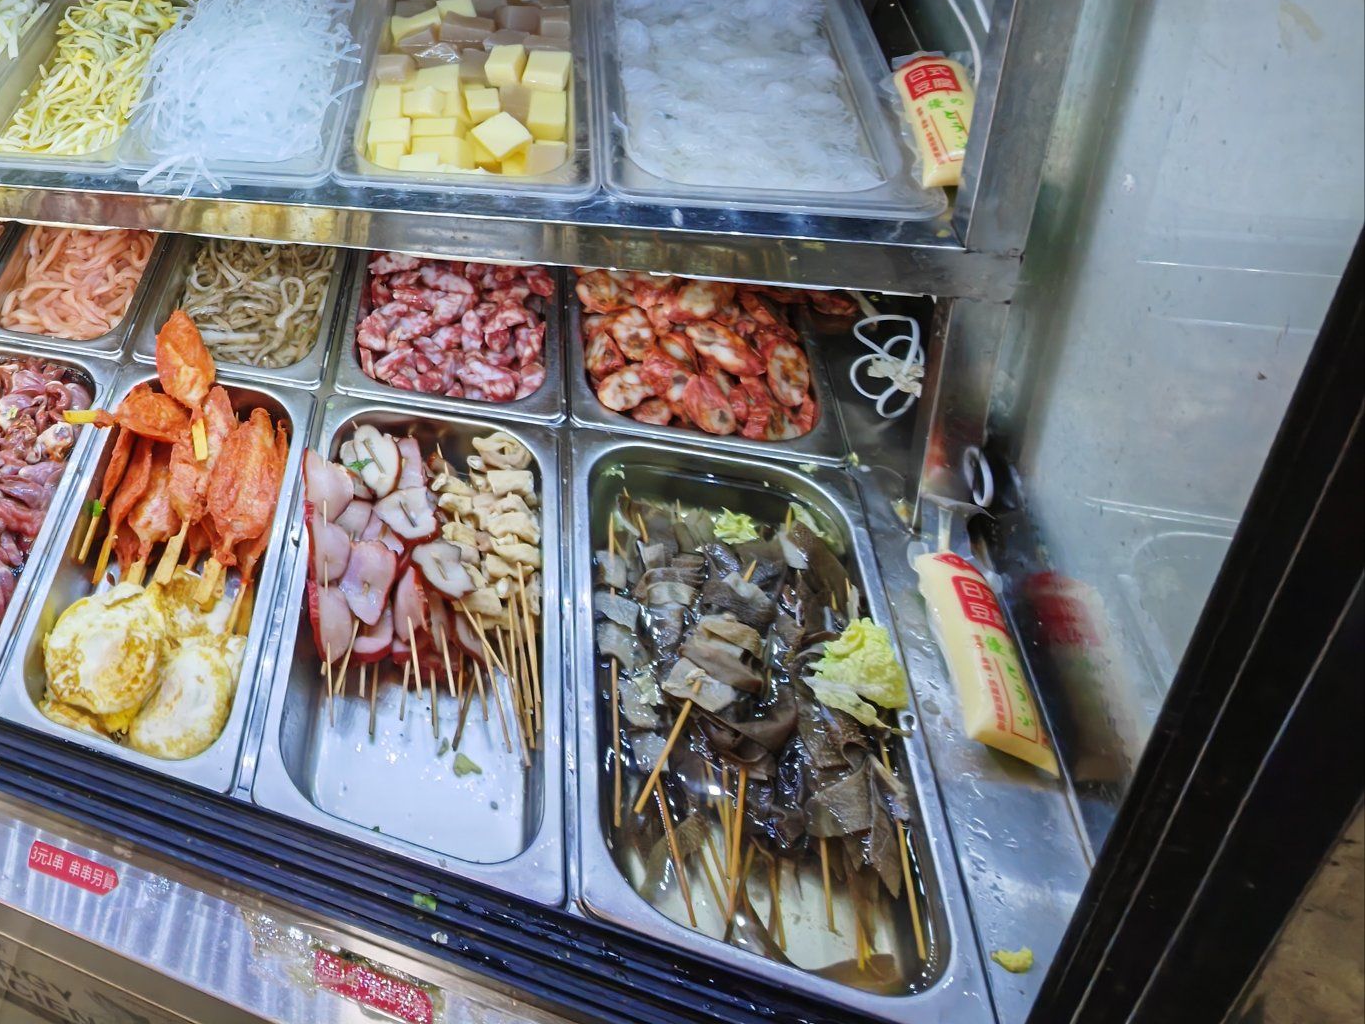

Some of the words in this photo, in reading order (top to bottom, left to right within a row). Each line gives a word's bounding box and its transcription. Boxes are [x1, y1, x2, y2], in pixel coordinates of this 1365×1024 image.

[30, 845, 64, 871] 3元1串
[68, 860, 116, 890] 串串另算
